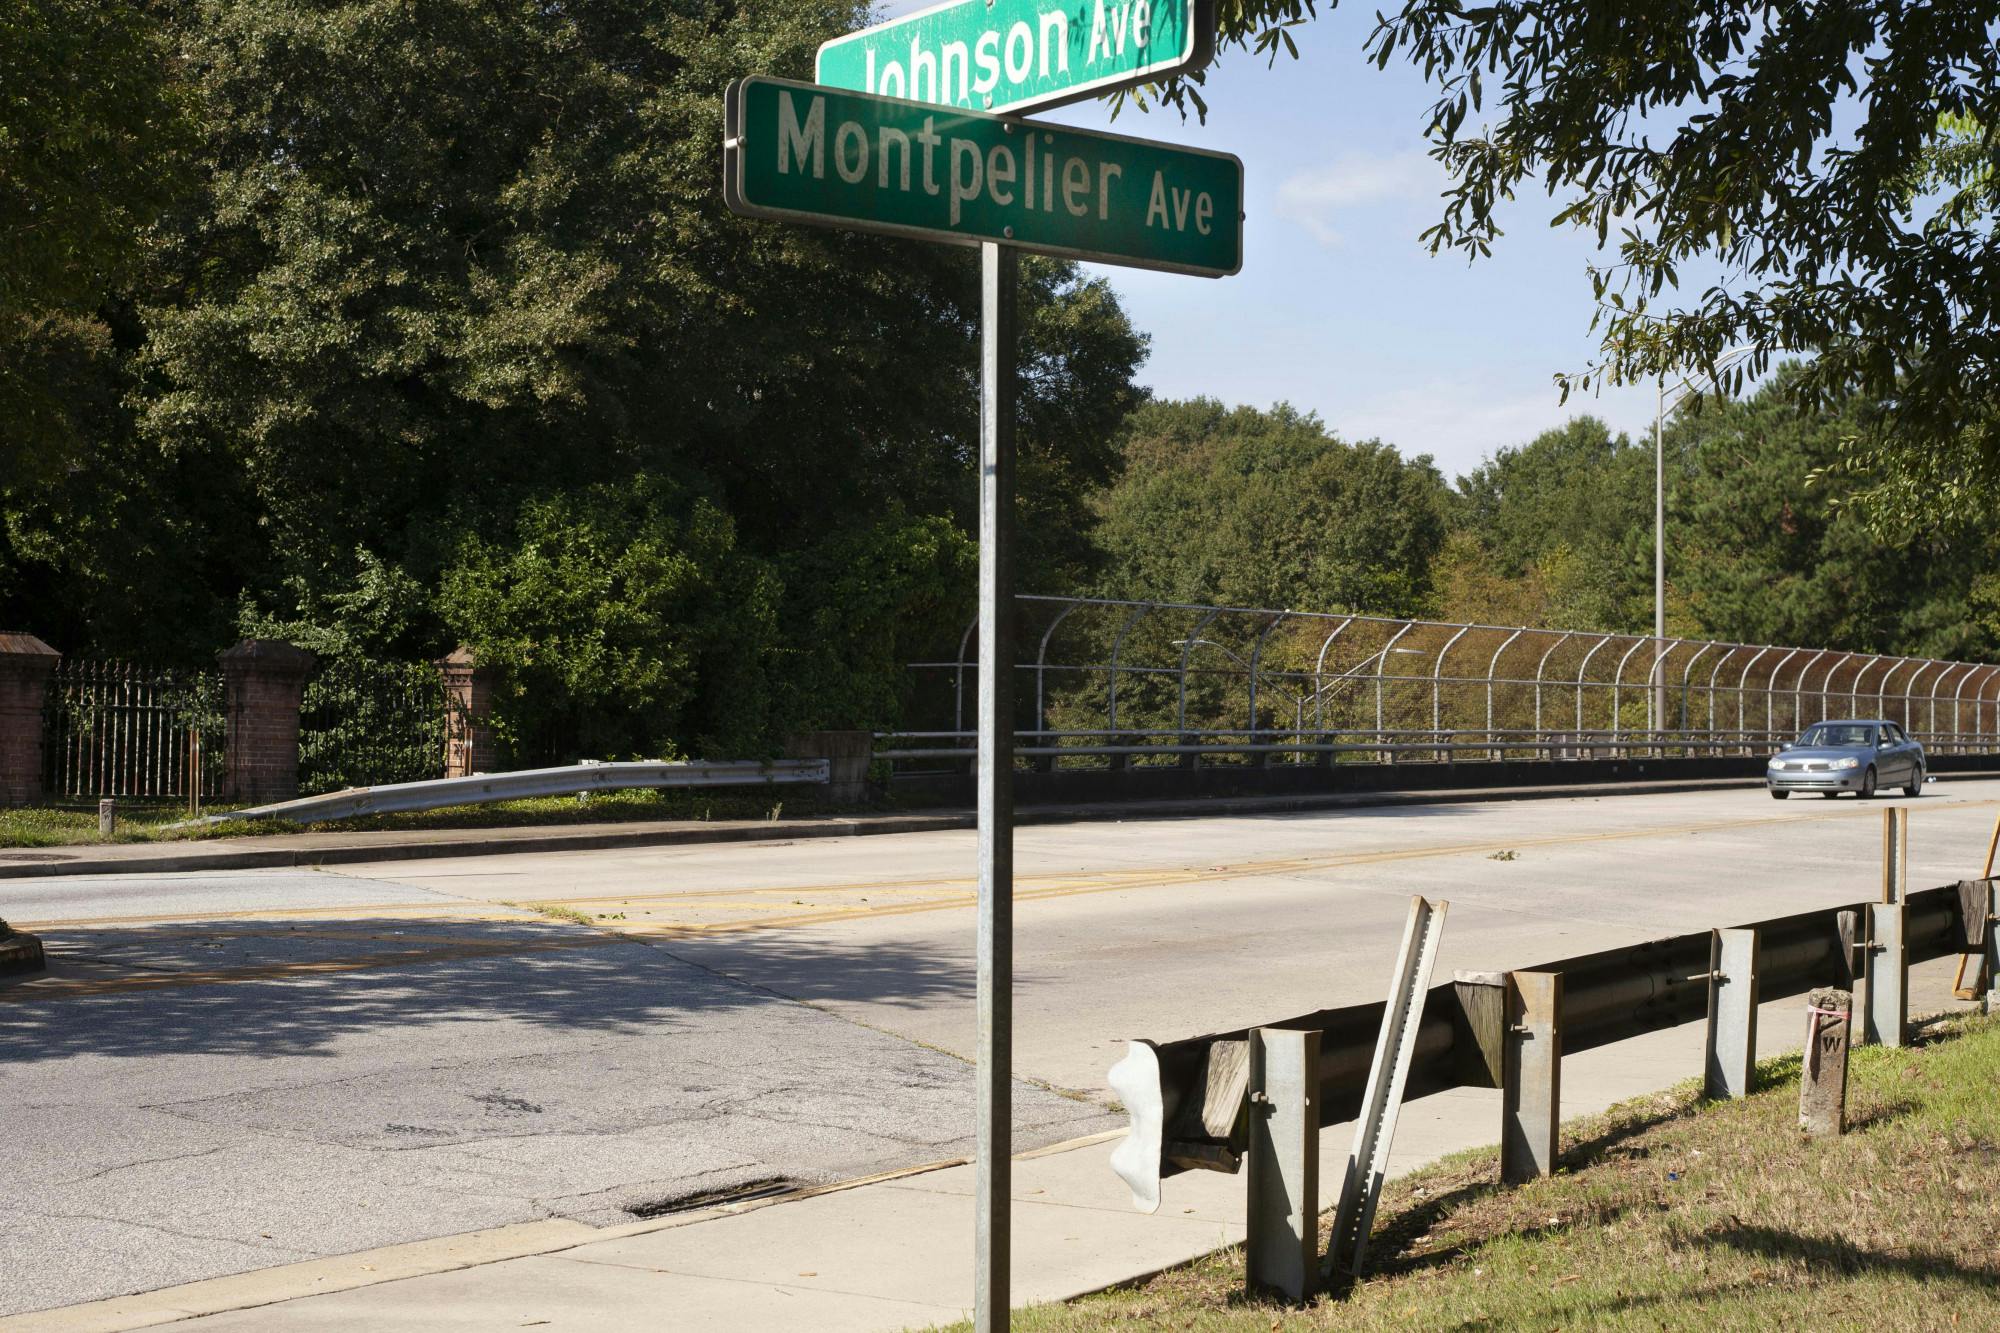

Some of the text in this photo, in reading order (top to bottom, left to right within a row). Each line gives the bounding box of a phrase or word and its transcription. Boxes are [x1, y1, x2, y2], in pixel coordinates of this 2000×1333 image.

[1086, 0, 1149, 65] Ave
[777, 90, 1213, 236] Montpelier Ave
[1822, 1036, 1842, 1053] W
